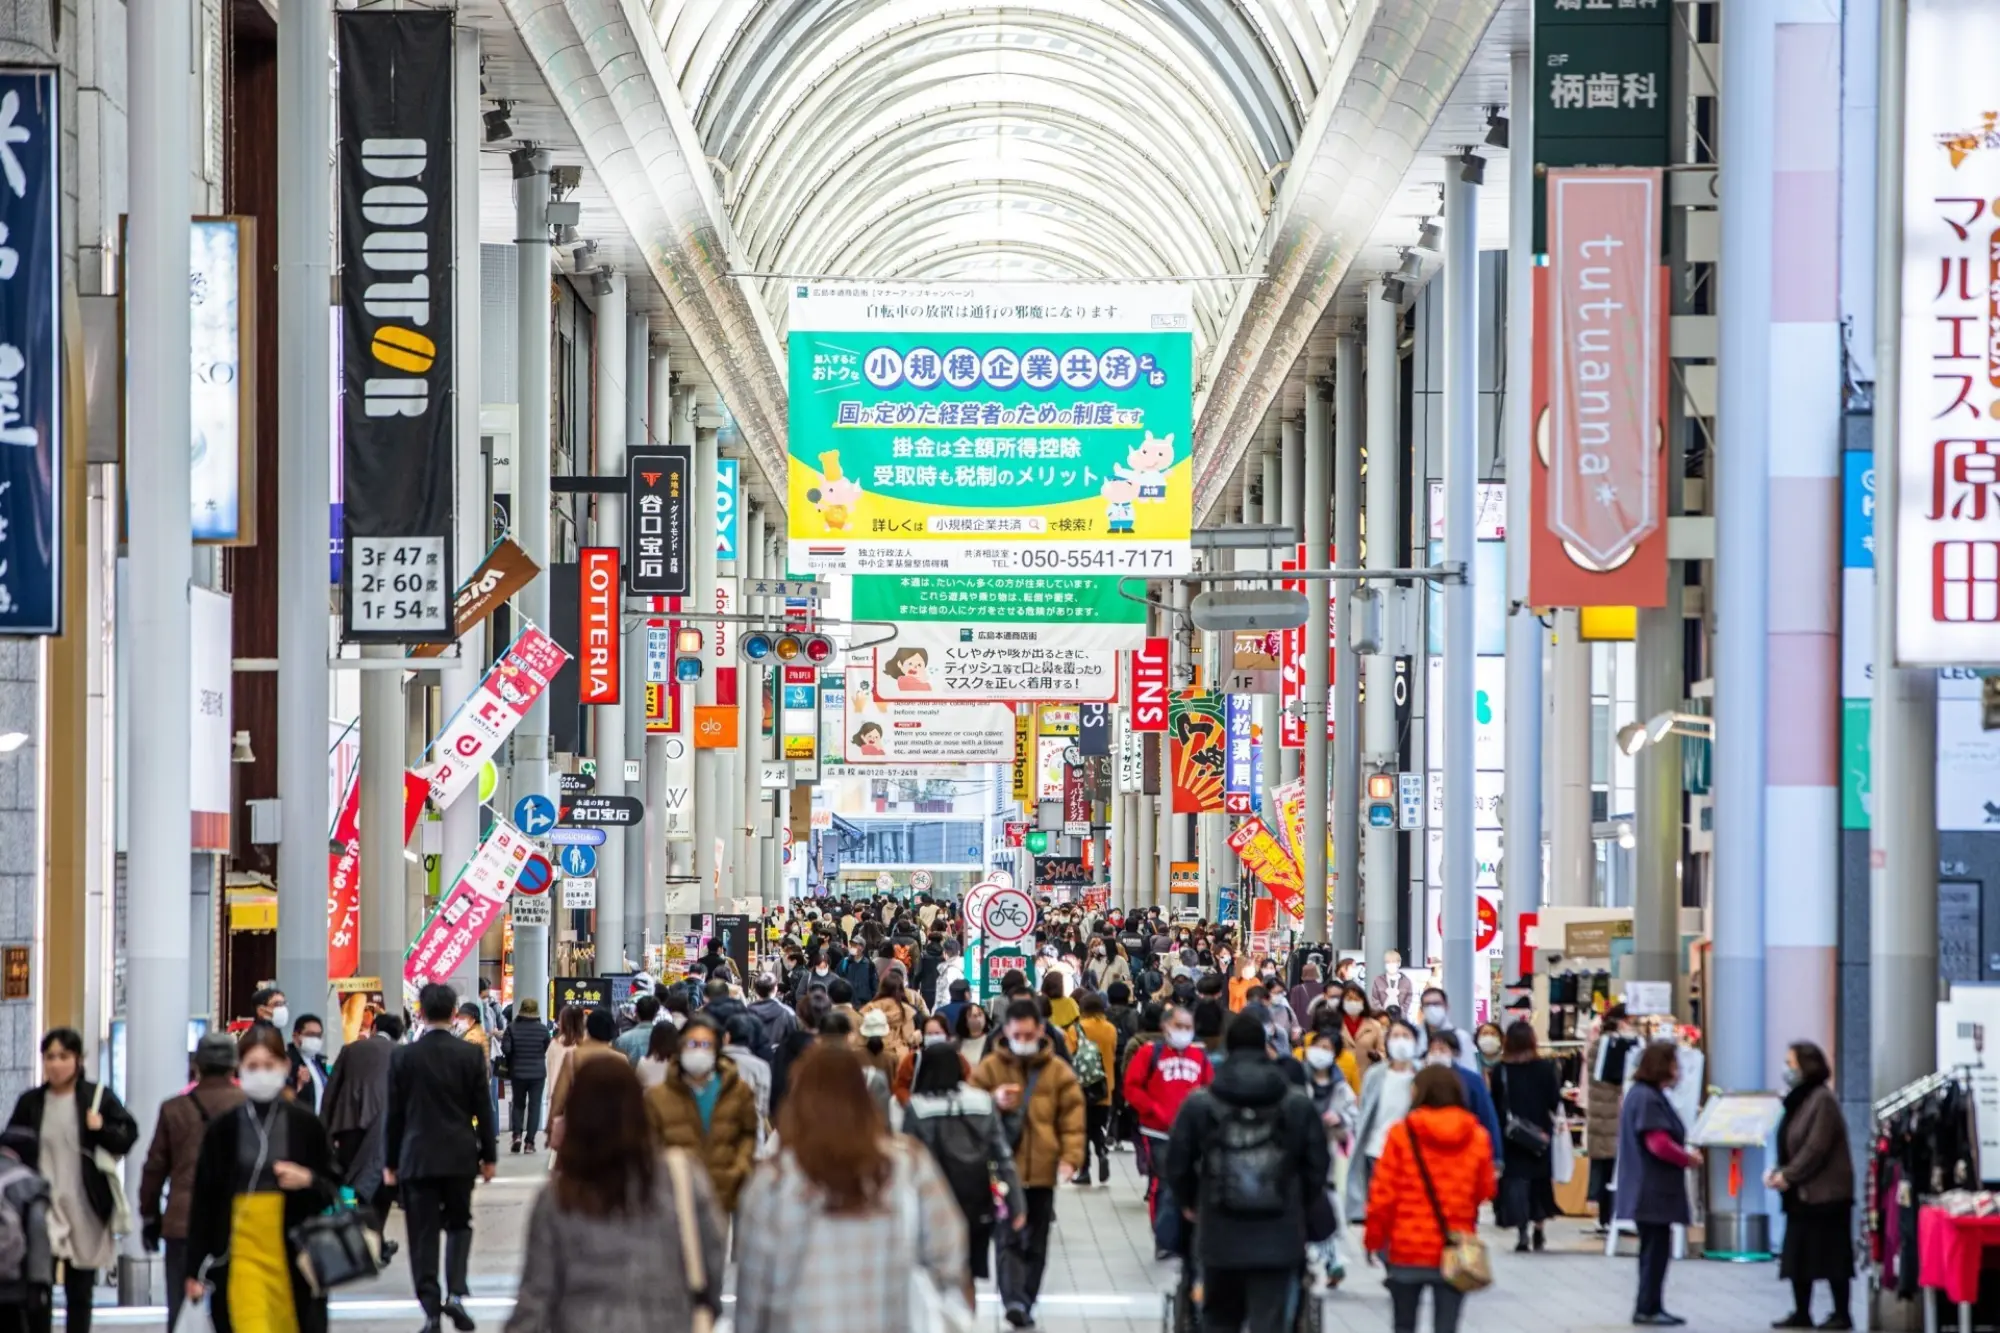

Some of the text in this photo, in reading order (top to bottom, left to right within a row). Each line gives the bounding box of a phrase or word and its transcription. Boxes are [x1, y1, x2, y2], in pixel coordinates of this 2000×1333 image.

[1549, 72, 1658, 109] 柄歯科
[361, 138, 437, 418] DOUTOR
[812, 365, 860, 382] おトクな
[837, 401, 1144, 426] 国が定めた経営者のための制度です
[892, 436, 1082, 460] 掛金は全額所得控除
[873, 464, 1099, 488] 受取時も税制のメリット
[872, 518, 924, 532] 詳しくは
[935, 518, 1022, 532] 小規模企業共済
[638, 494, 663, 578] 谷口宝石
[361, 547, 386, 566] 3F
[858, 548, 913, 557] 独立行政法人
[964, 549, 1010, 559] 共済相談室
[858, 559, 949, 569] 中小企業基盤整備機構
[991, 559, 1010, 569] TEL
[361, 574, 386, 592] 2F
[362, 601, 385, 619] 1F
[590, 554, 609, 697] LOTTERIA
[977, 631, 1038, 641] 広島本通商店街
[944, 661, 1102, 674] ティッシュ等で口と鼻を覆ったり
[1233, 675, 1253, 689] 1F
[894, 708, 915, 716] before
[700, 715, 722, 736] glo
[915, 730, 928, 738] you
[963, 730, 984, 738] cough
[572, 807, 630, 822] 谷口宝石
[989, 956, 1027, 970] 自転車
